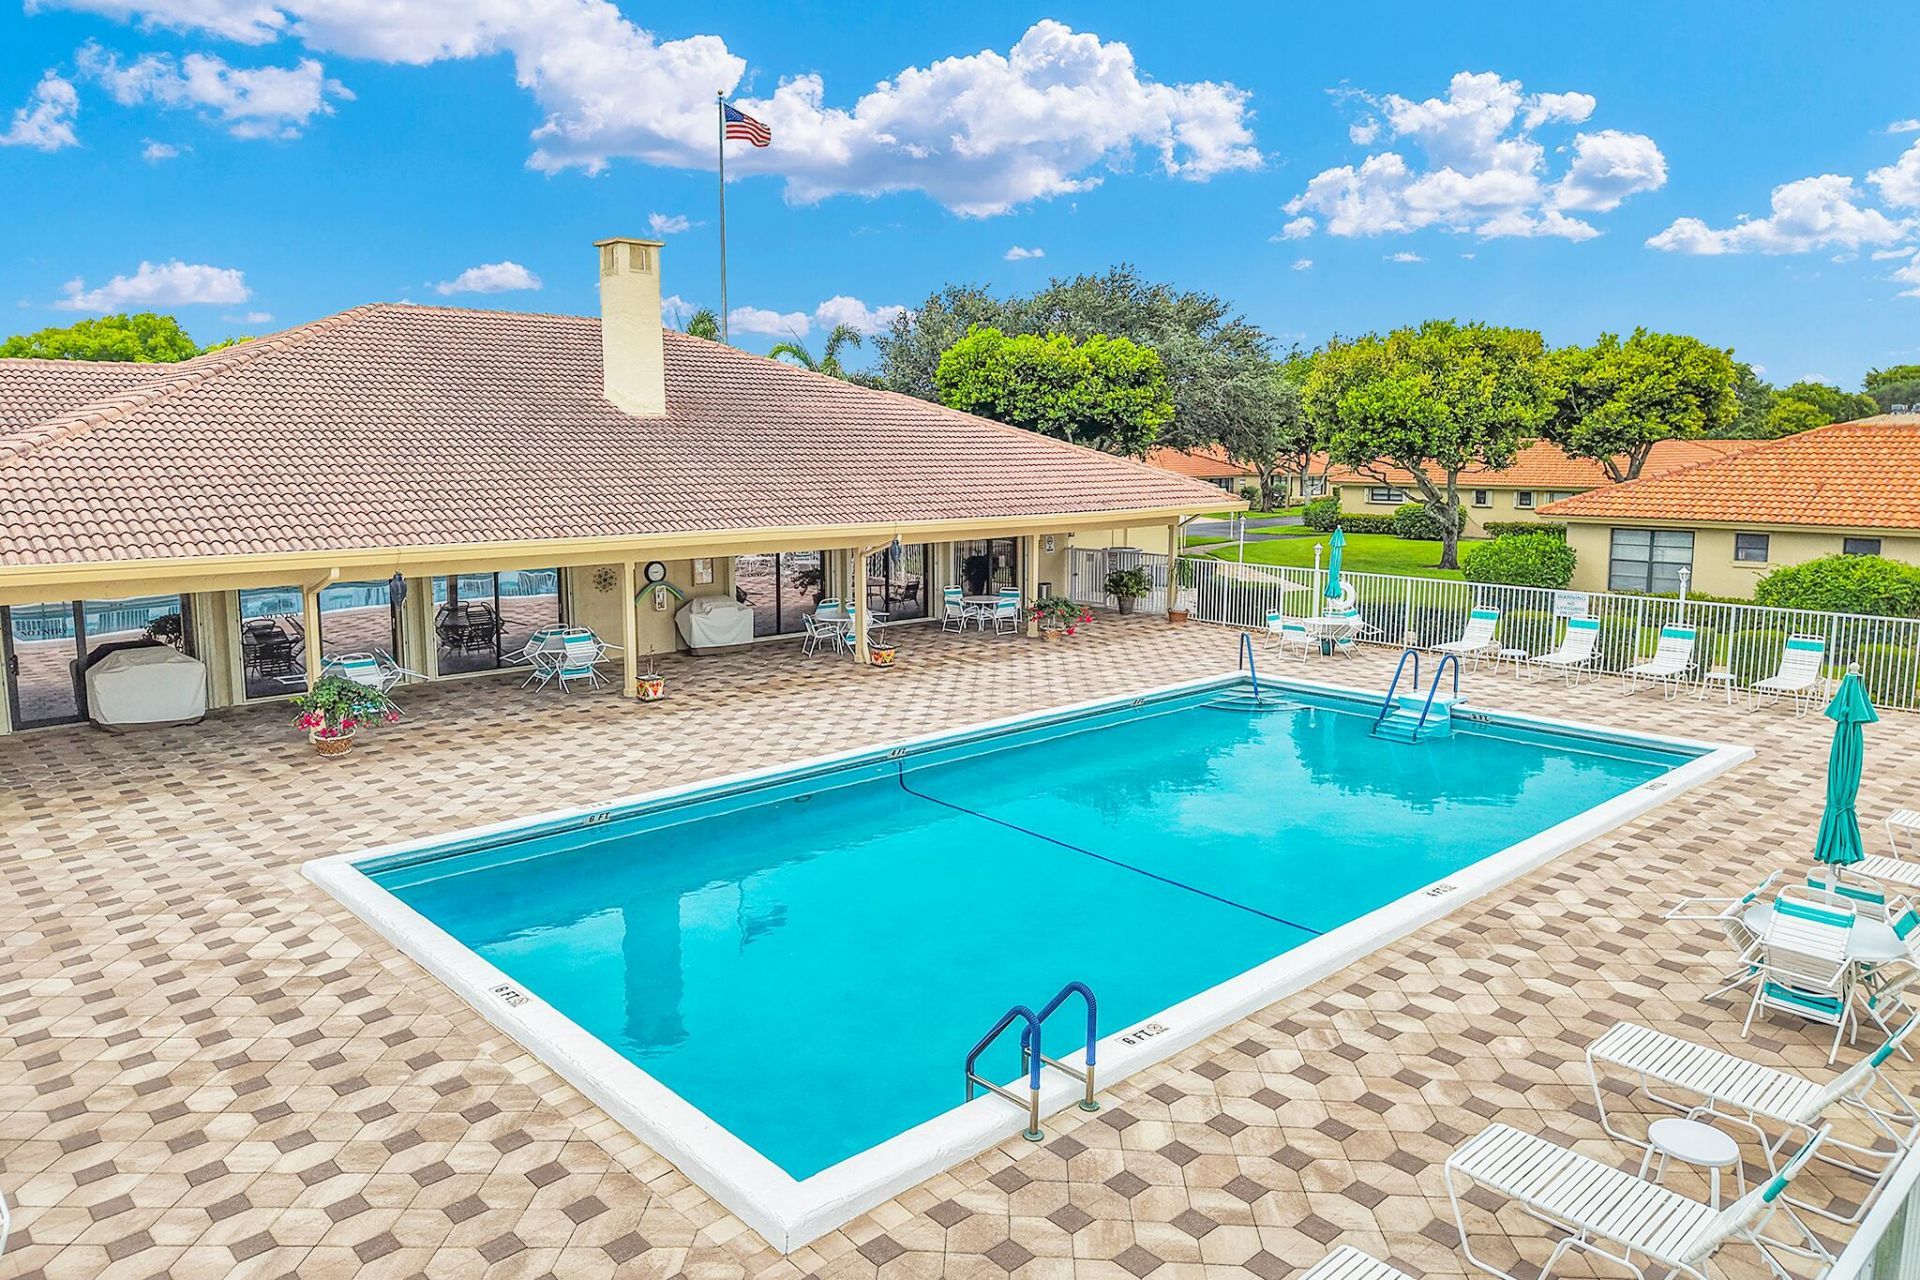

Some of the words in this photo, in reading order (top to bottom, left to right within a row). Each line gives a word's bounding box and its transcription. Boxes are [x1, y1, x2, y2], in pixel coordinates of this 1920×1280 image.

[37, 627, 67, 636] ENTRY
[598, 812, 610, 821] FT
[1122, 1037, 1136, 1045] 6
